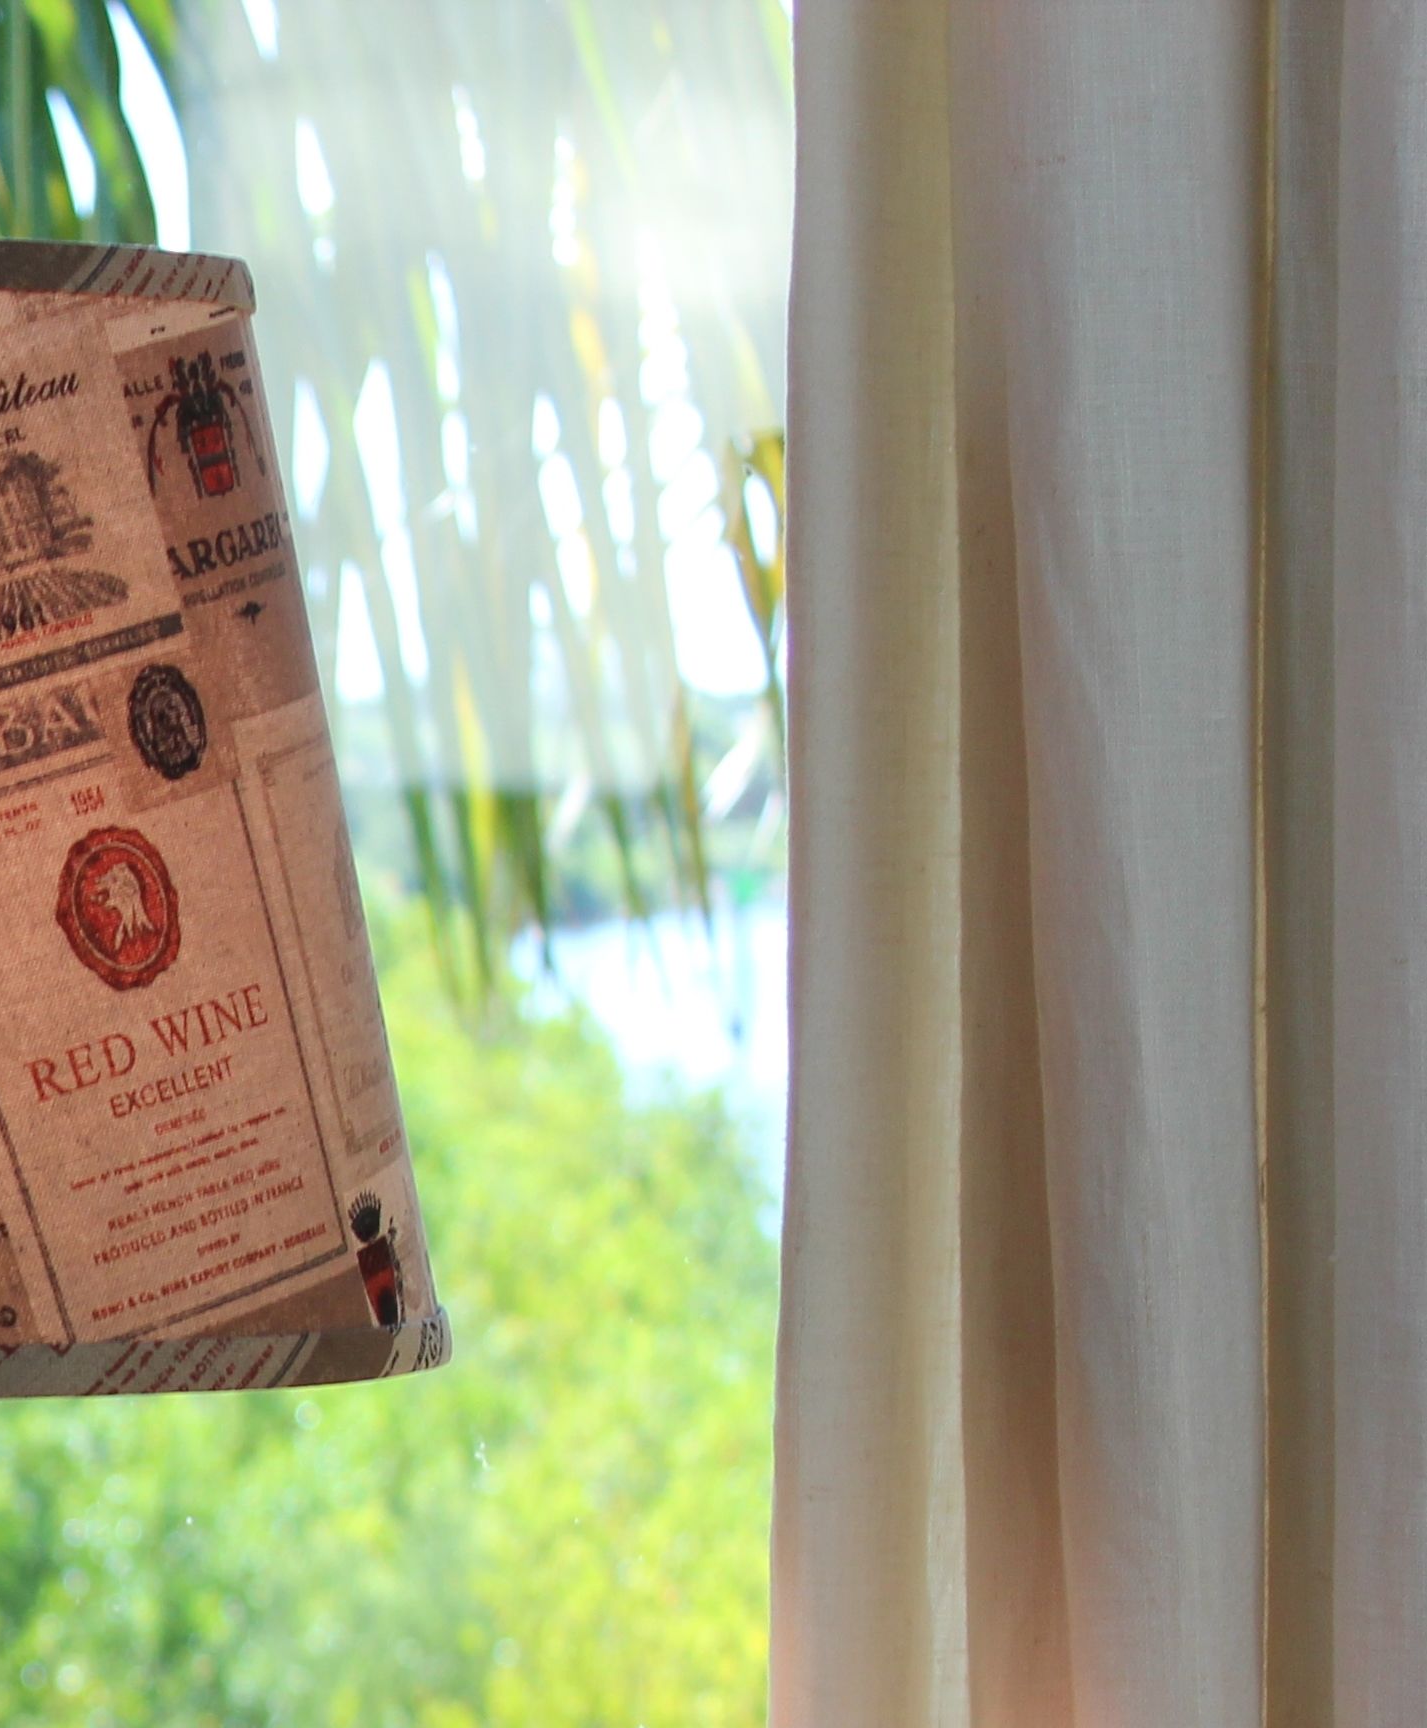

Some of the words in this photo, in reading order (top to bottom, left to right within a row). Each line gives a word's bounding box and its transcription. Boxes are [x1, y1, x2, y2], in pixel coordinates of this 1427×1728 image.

[24, 1034, 137, 1102] RED
[150, 984, 268, 1056] WINE
[111, 1056, 234, 1118] EXCELLENT
[167, 1219, 195, 1239] AND
